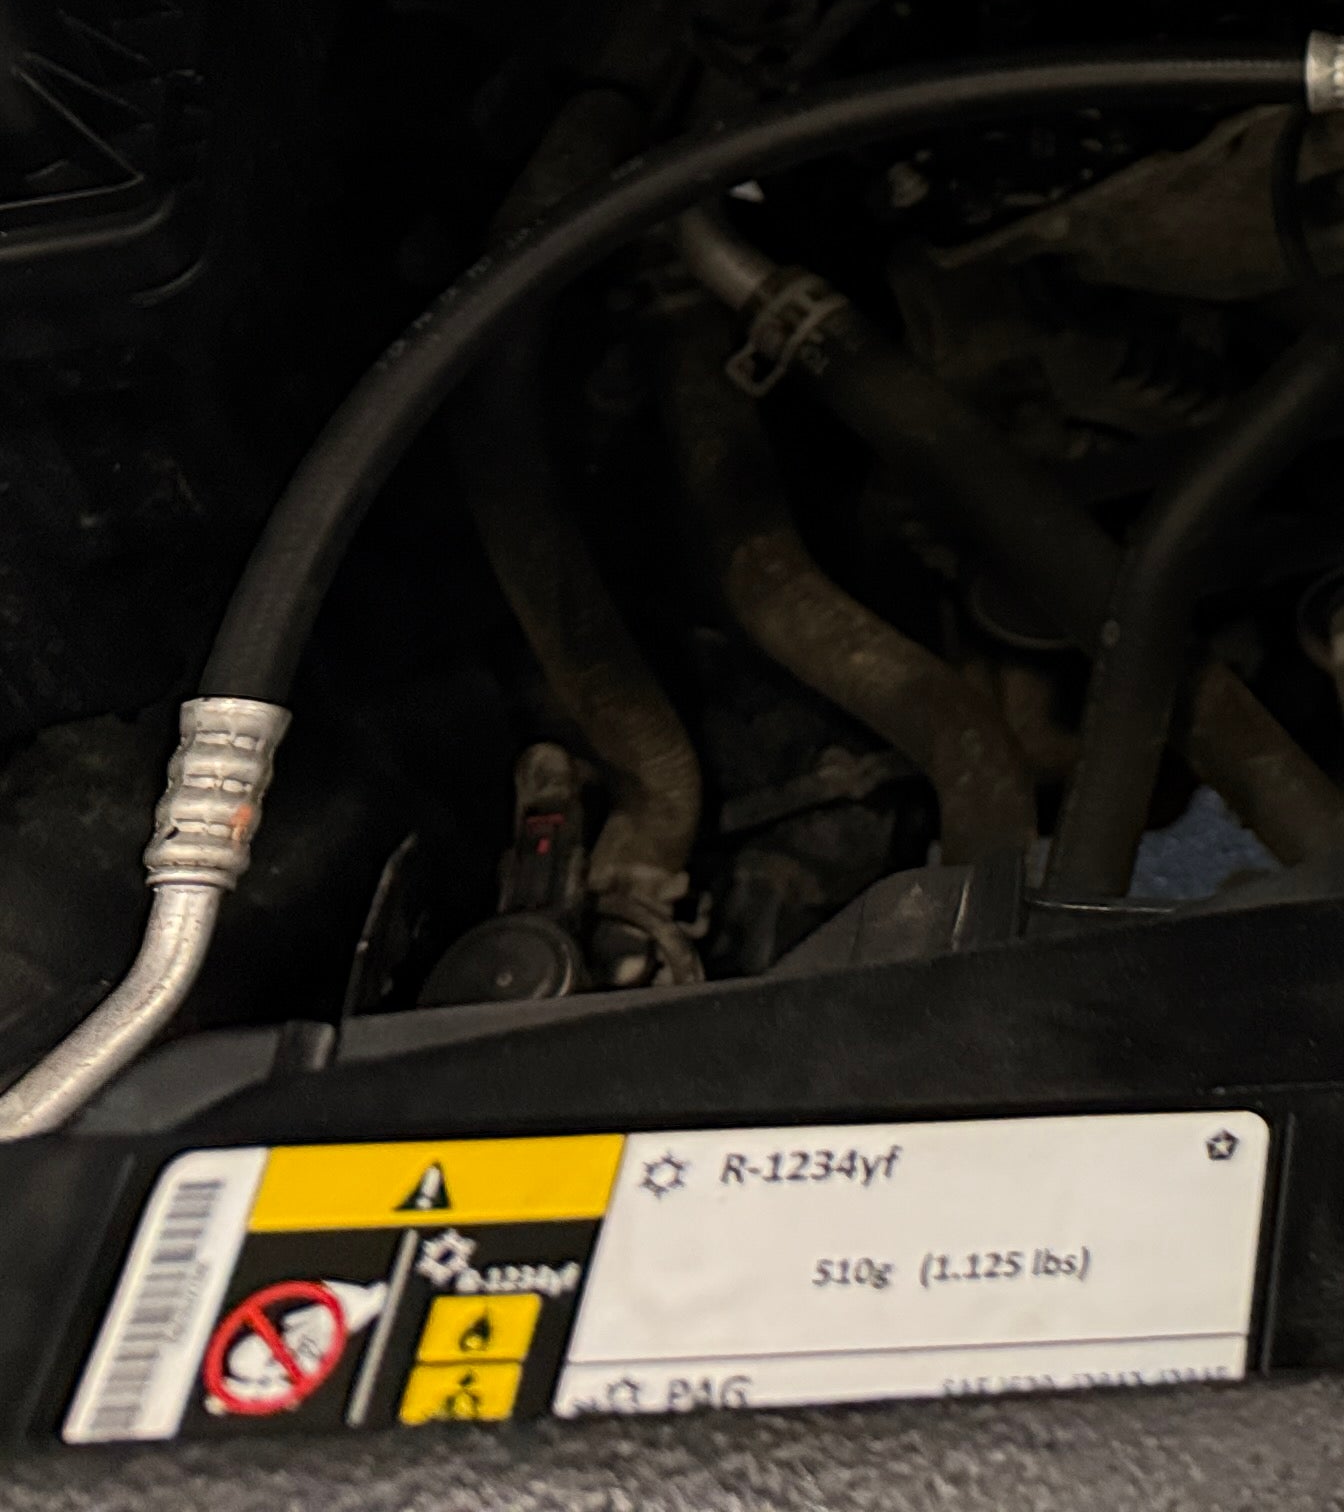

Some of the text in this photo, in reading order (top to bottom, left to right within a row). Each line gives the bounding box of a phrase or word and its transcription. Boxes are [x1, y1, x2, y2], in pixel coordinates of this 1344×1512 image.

[720, 1145, 903, 1188] R-1234yf
[812, 1246, 1091, 1289] 510g (1.125 lbs)
